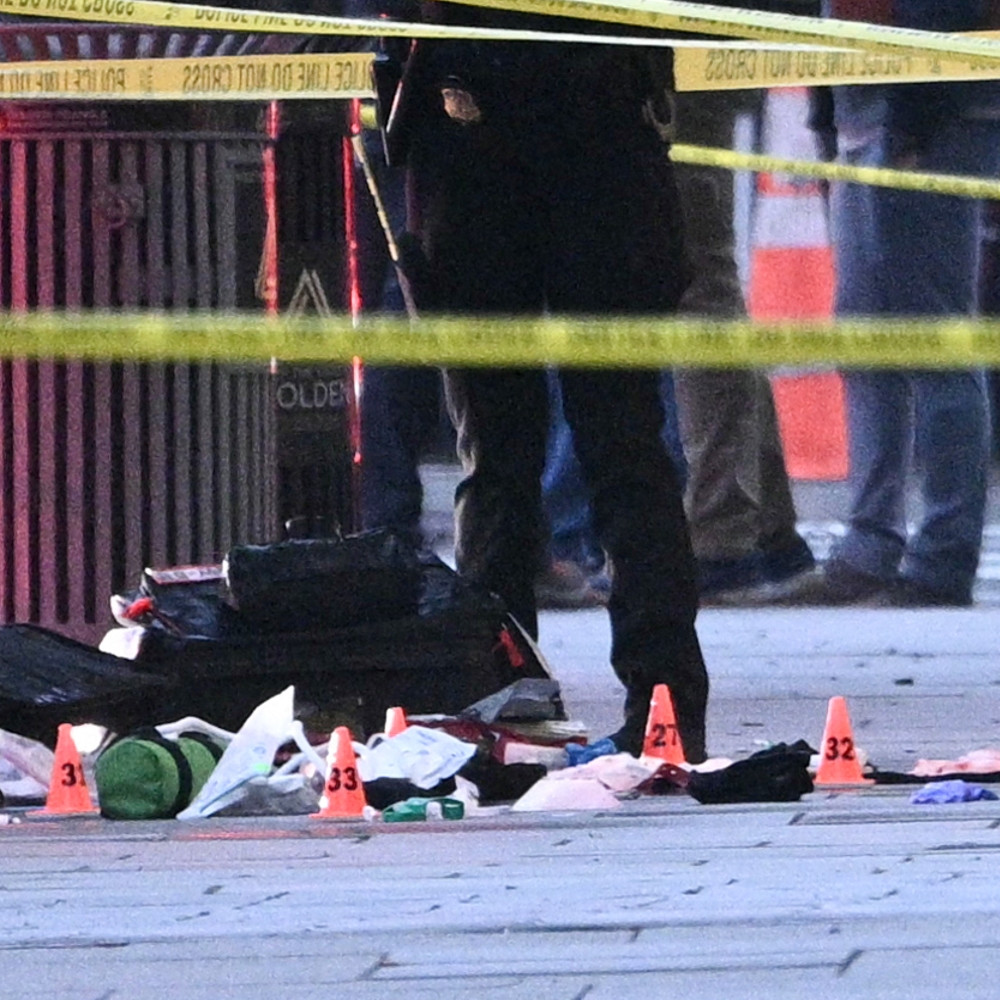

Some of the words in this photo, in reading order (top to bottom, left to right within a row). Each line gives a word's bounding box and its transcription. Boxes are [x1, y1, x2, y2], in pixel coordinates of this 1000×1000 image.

[277, 379, 351, 409] OLDE
[652, 723, 678, 748] 27
[825, 736, 855, 761] 32
[328, 766, 358, 792] 33
